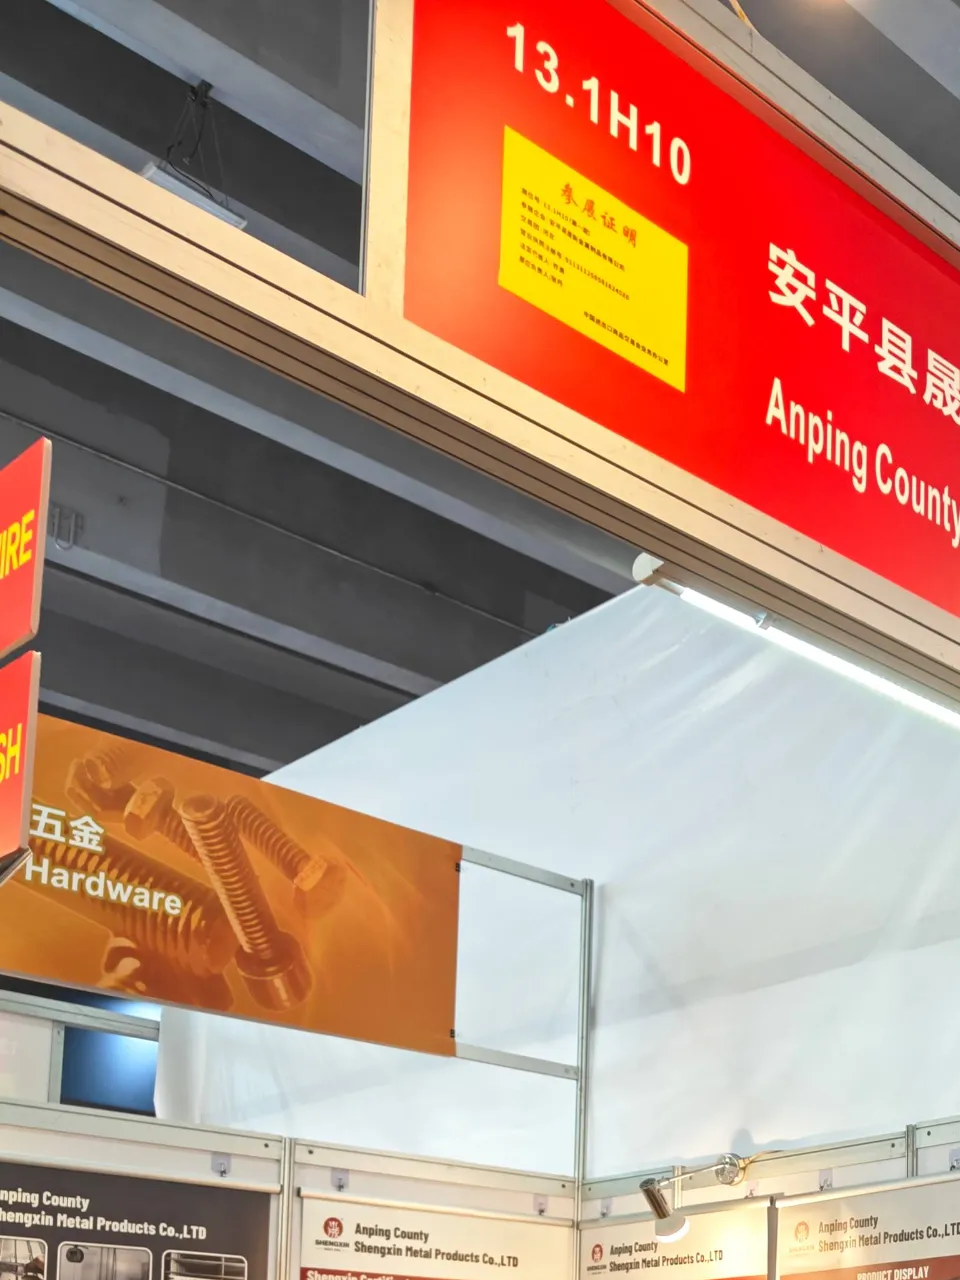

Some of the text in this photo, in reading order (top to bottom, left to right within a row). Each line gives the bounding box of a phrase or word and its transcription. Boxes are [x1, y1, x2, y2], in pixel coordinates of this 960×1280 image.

[506, 22, 691, 185] 13.1H10
[766, 377, 868, 492] Anping
[0, 509, 35, 580] IRE
[29, 804, 105, 852] 五金
[25, 856, 182, 915] Hardware
[42, 1191, 90, 1212] County
[57, 1213, 93, 1230] Metal
[97, 1217, 156, 1236] Products
[159, 1222, 206, 1239] Co.,LTD
[355, 1223, 429, 1243] Anping County
[818, 1215, 878, 1235] Anping County
[315, 1239, 350, 1248] SHENGXIN
[610, 1241, 658, 1257] Anping County
[818, 1238, 856, 1253] Shengxin
[858, 1233, 881, 1247] Metal
[883, 1228, 924, 1244] Products
[354, 1241, 519, 1267] Shengxin Metal Products Co.,LTD
[609, 1259, 640, 1273] Shengxin
[641, 1257, 660, 1269] Metal
[662, 1254, 694, 1267] Products
[893, 1265, 929, 1280] DISPLAY
